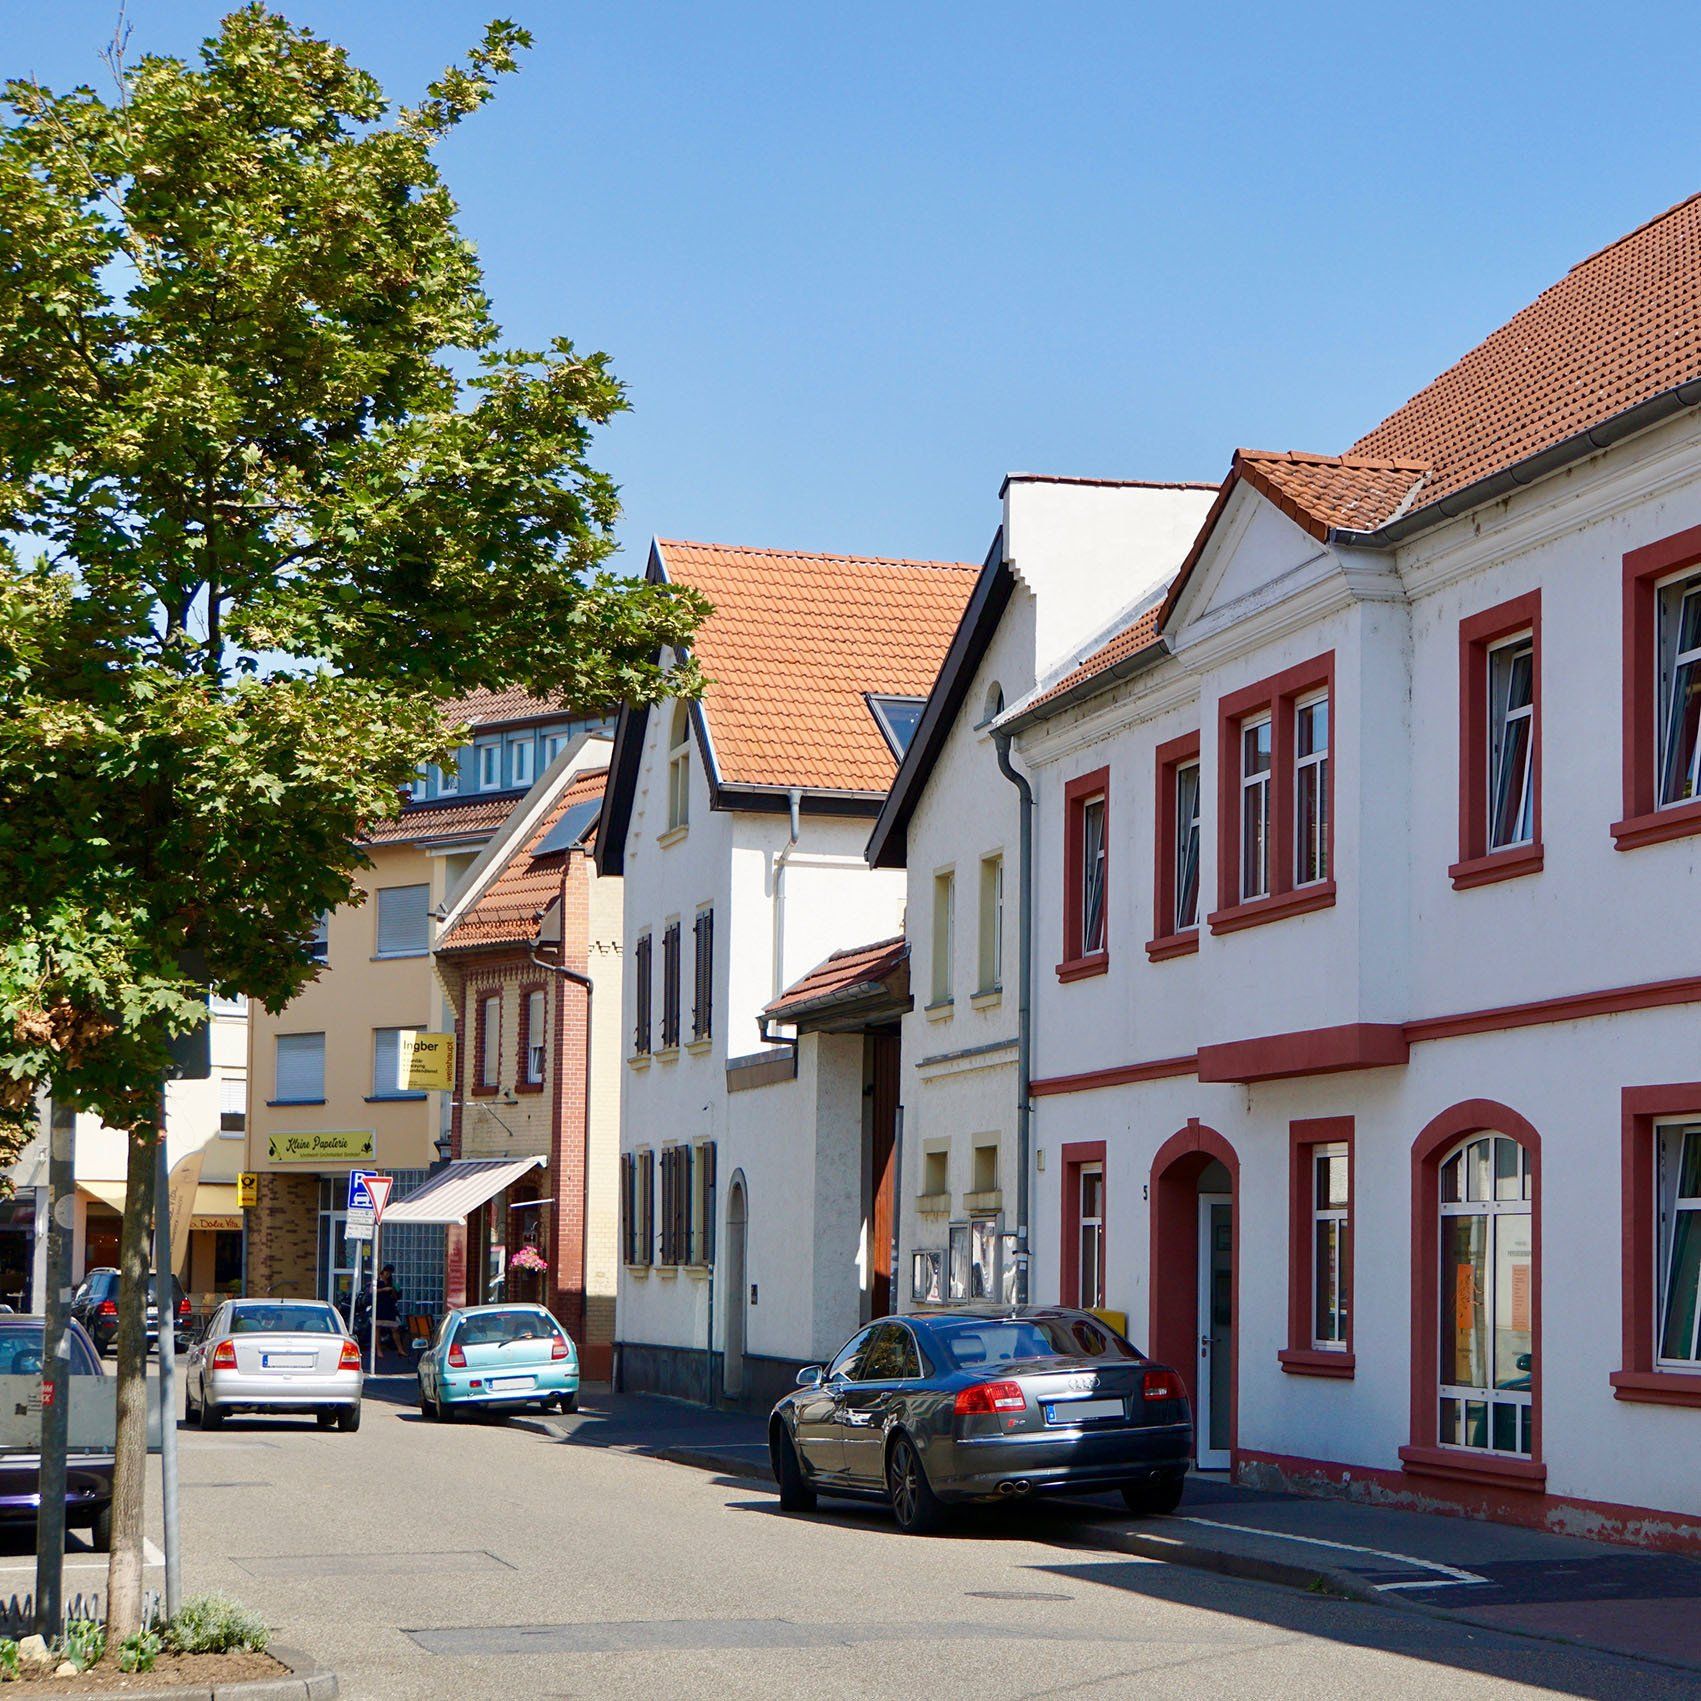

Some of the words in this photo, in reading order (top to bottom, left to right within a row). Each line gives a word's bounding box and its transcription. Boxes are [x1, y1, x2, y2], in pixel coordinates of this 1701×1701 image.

[404, 1040, 439, 1053] Ingber
[286, 1137, 310, 1154] Kleine
[312, 1135, 348, 1150] Papeterie
[354, 1172, 366, 1188] P
[1143, 1185, 1148, 1201] 5
[200, 1218, 224, 1229] Dolce
[225, 1217, 240, 1229] Vita
